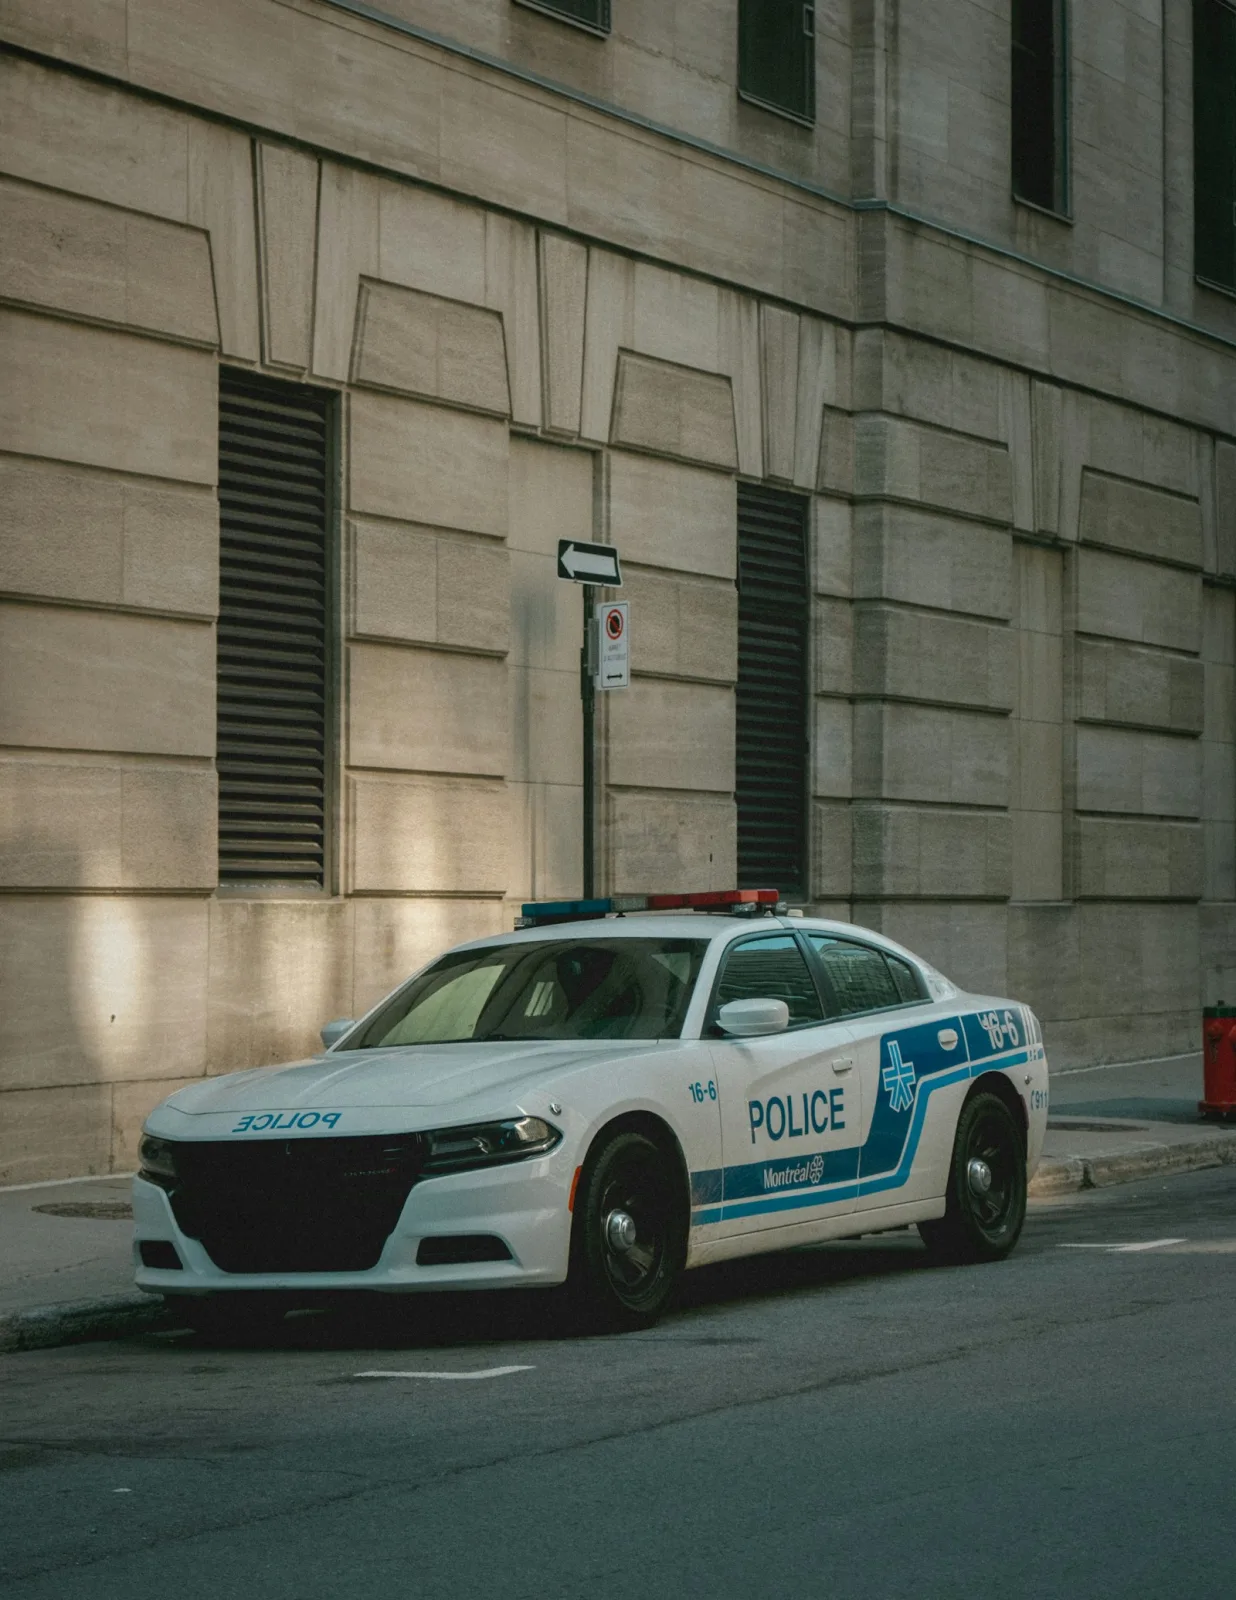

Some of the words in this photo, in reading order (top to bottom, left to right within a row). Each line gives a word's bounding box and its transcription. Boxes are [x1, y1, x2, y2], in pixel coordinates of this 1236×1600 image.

[983, 1010, 1019, 1050] 16-6
[689, 1080, 717, 1103] 16-6
[749, 1087, 846, 1144] POLICE
[763, 1161, 810, 1189] Montréal
